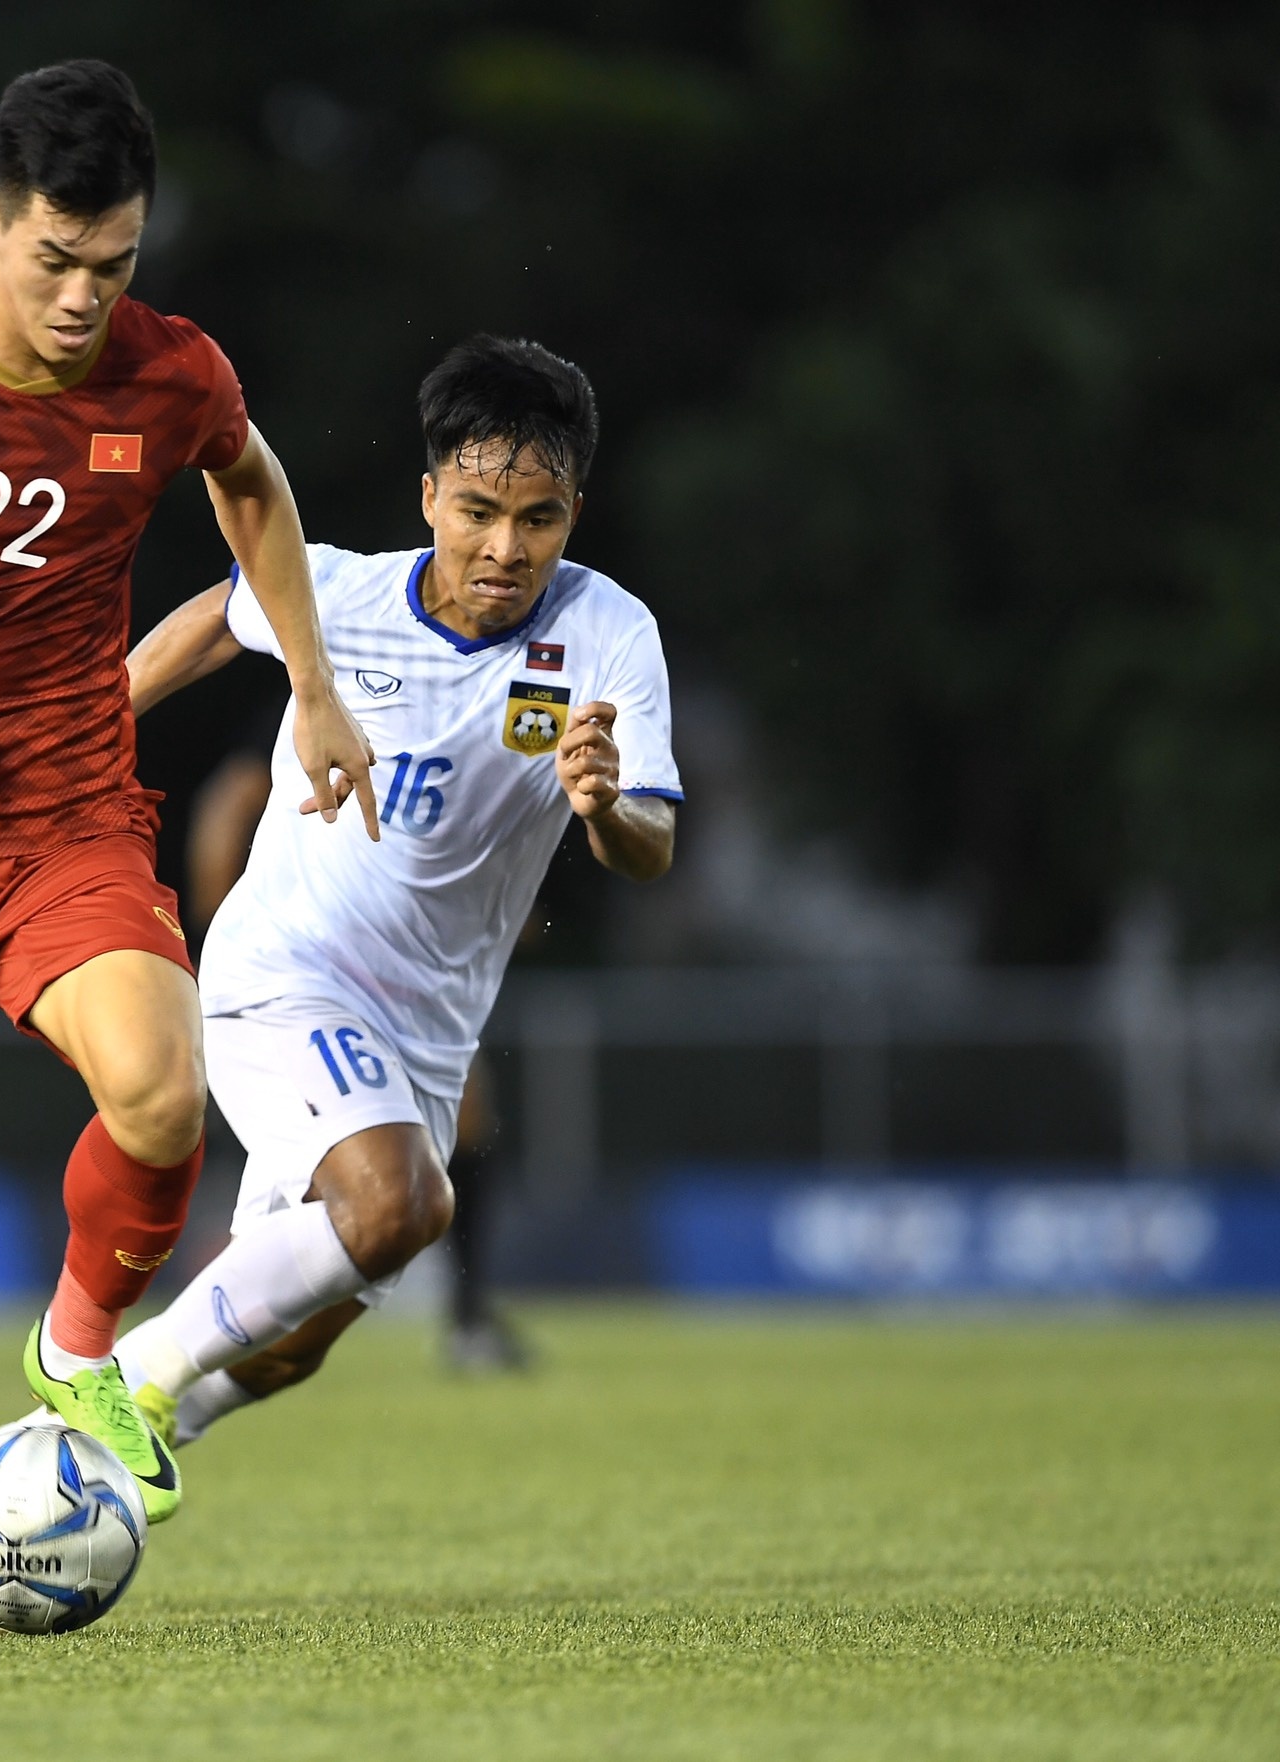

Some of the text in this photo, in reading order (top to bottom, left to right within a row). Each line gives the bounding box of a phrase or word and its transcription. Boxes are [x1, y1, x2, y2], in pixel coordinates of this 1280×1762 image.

[527, 690, 553, 701] LAOS
[380, 751, 454, 836] 16
[309, 1027, 387, 1096] 16
